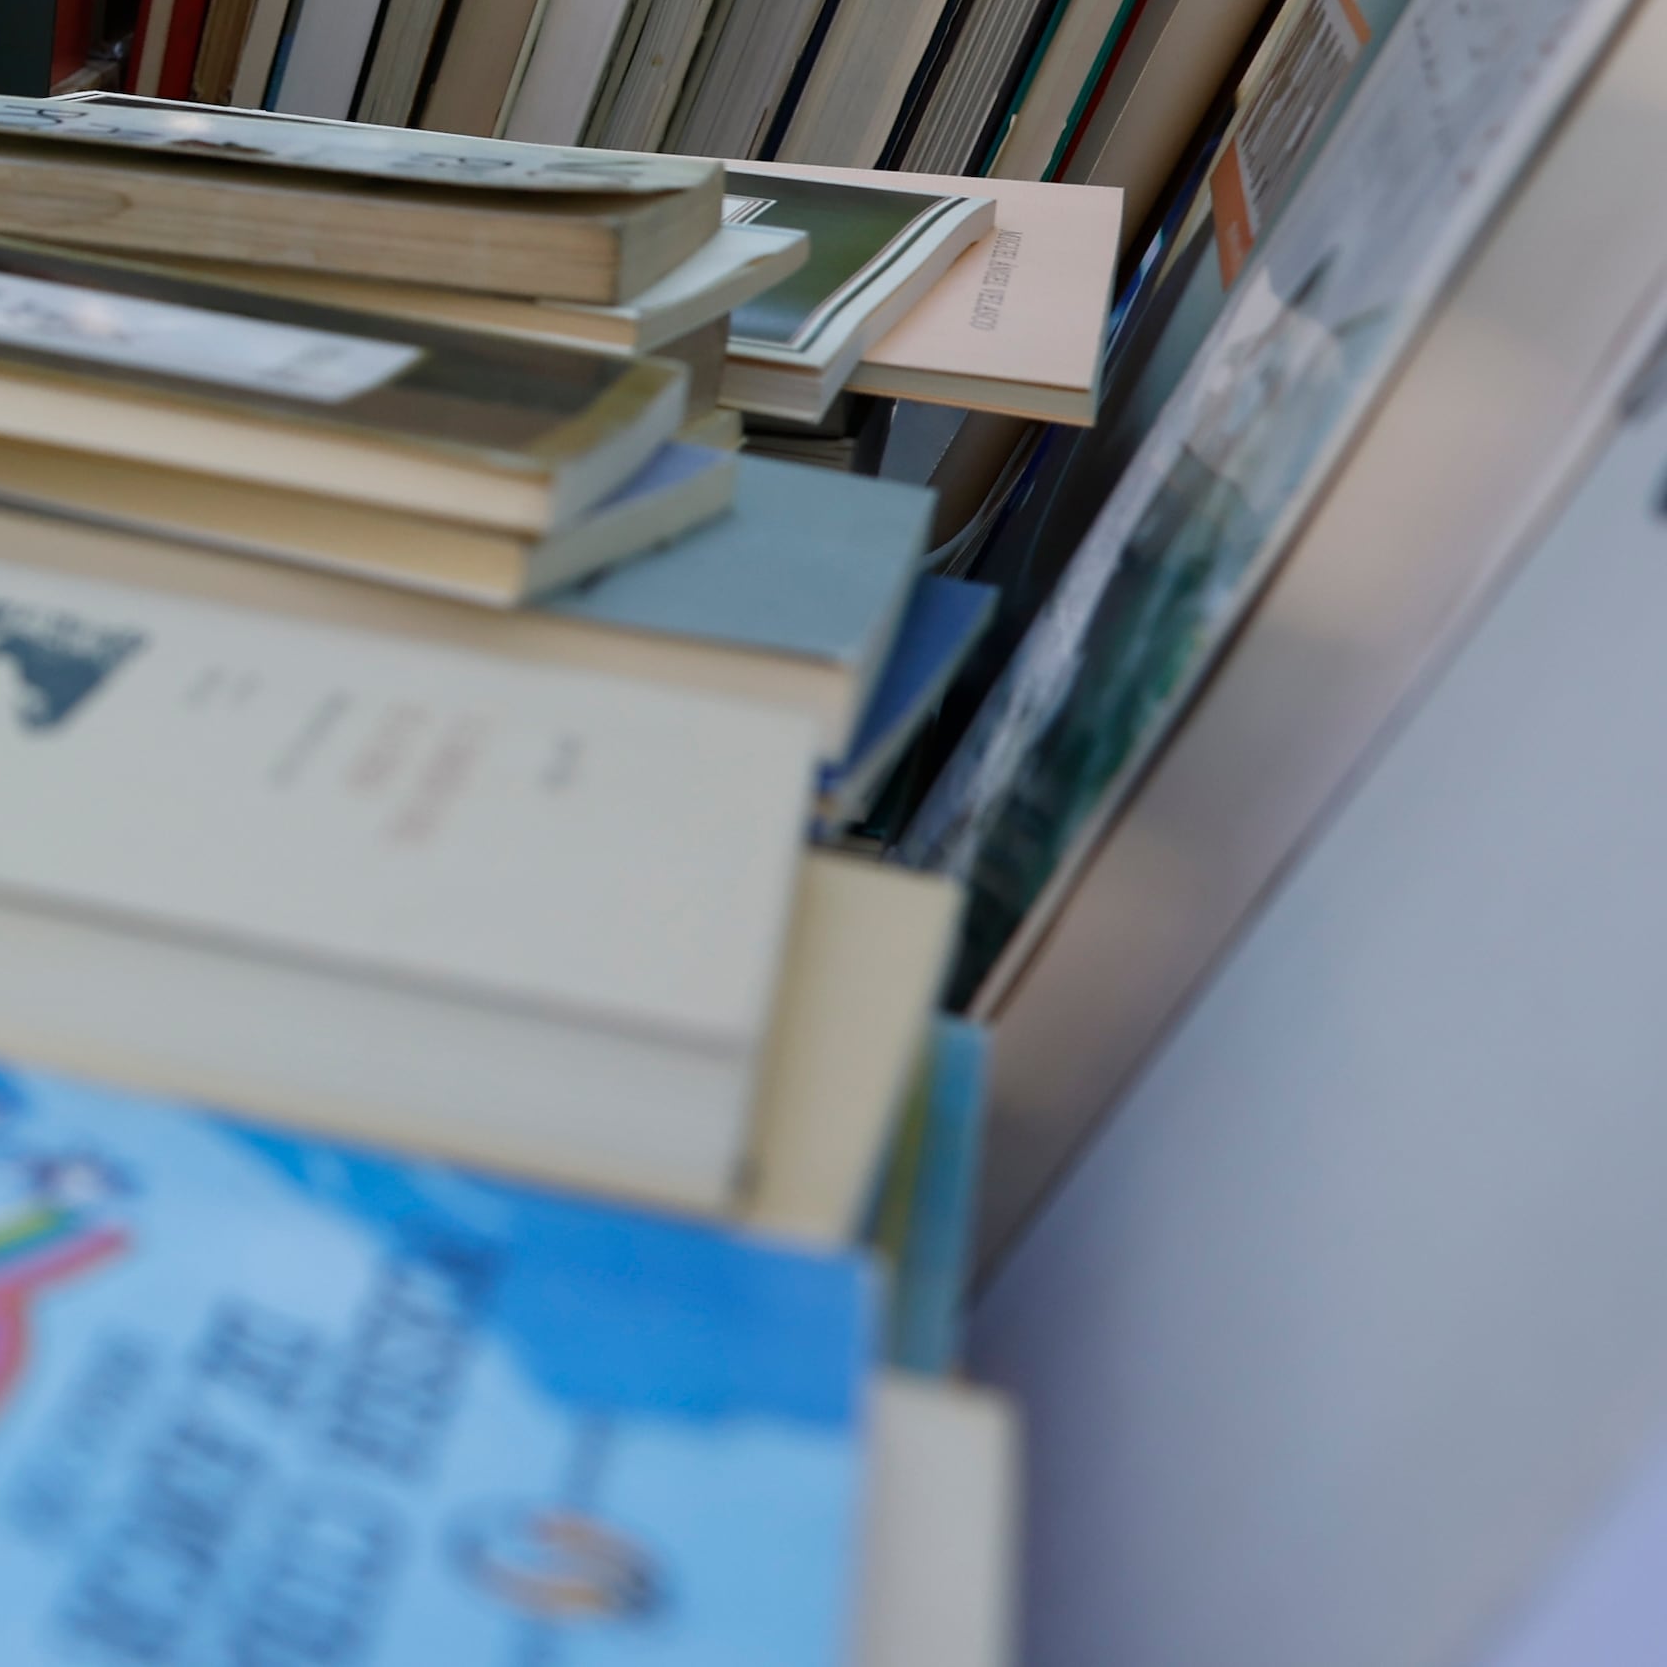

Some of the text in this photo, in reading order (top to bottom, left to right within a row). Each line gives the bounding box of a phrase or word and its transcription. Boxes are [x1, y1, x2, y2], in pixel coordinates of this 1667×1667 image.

[968, 229, 1024, 332] MIGUEL ÁNGEL VELASCO
